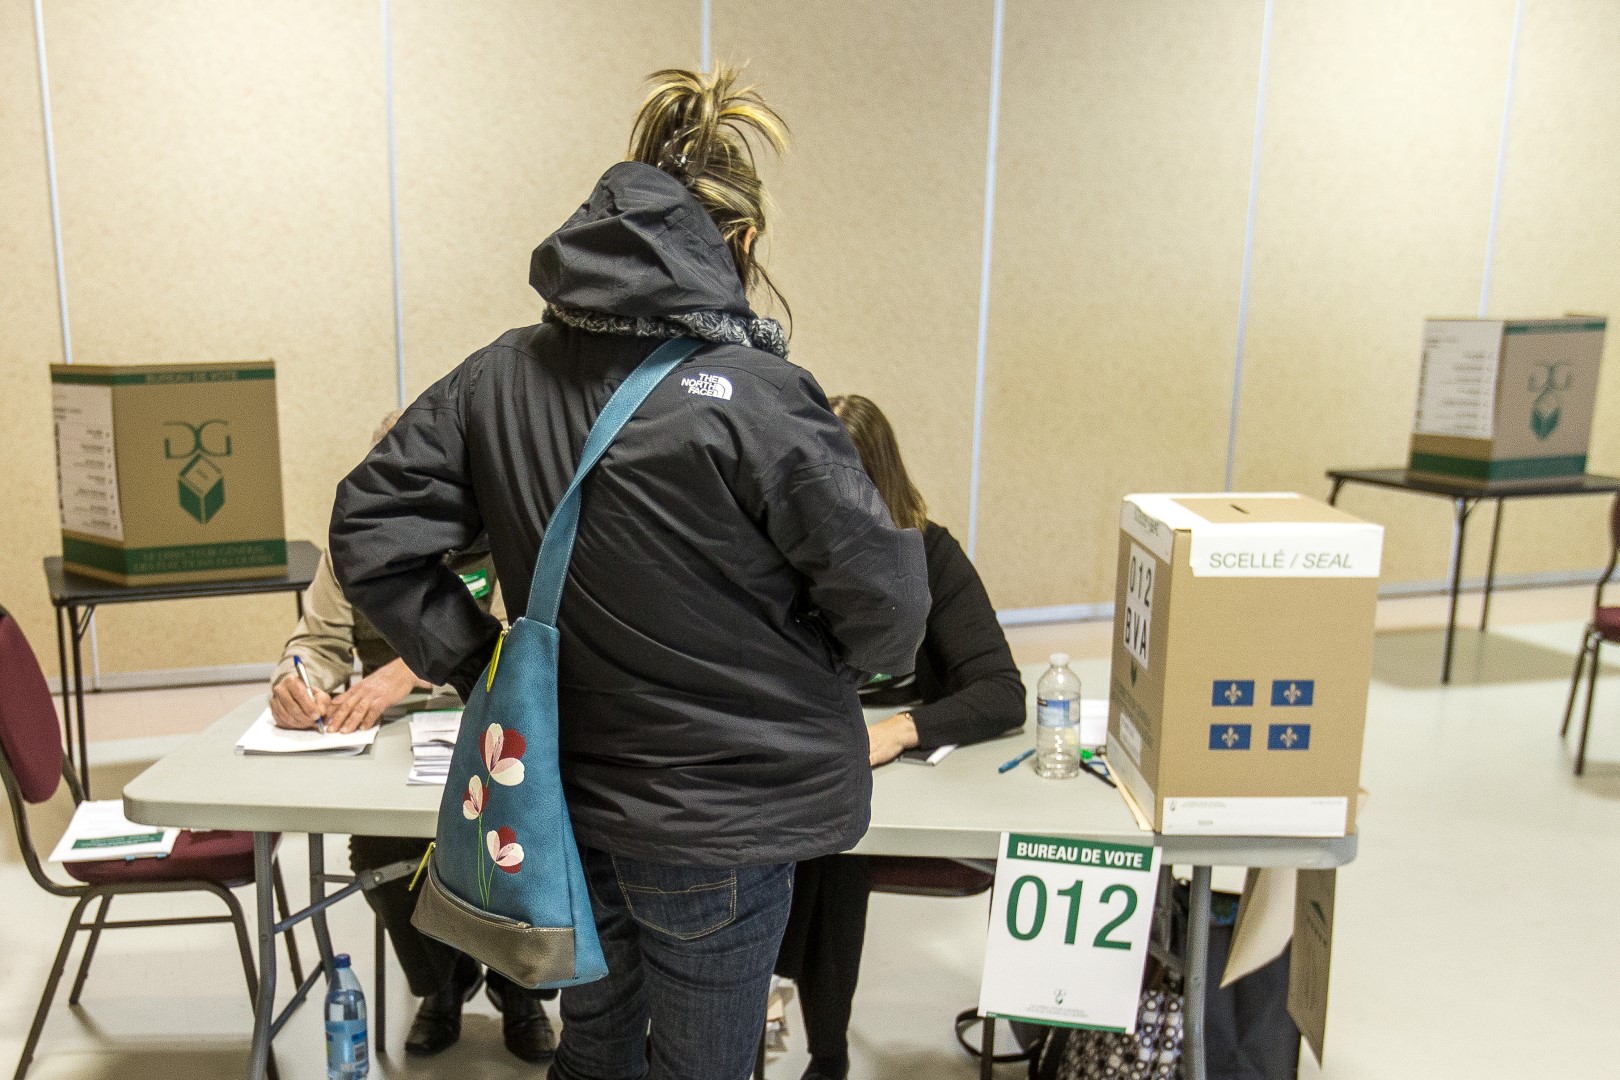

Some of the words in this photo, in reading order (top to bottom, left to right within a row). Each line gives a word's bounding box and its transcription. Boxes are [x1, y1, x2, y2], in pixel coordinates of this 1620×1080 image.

[681, 378, 716, 390] NORTH
[699, 373, 719, 383] THE
[688, 386, 714, 396] FACE
[1209, 549, 1286, 569] SCELLÉ
[1302, 553, 1353, 569] SEAL
[1130, 556, 1152, 607] 012
[1126, 607, 1147, 659] BVA
[1016, 841, 1078, 862] BUREAU
[1081, 848, 1101, 864] DE
[1104, 849, 1143, 868] VOTE
[1006, 874, 1138, 951] 012
